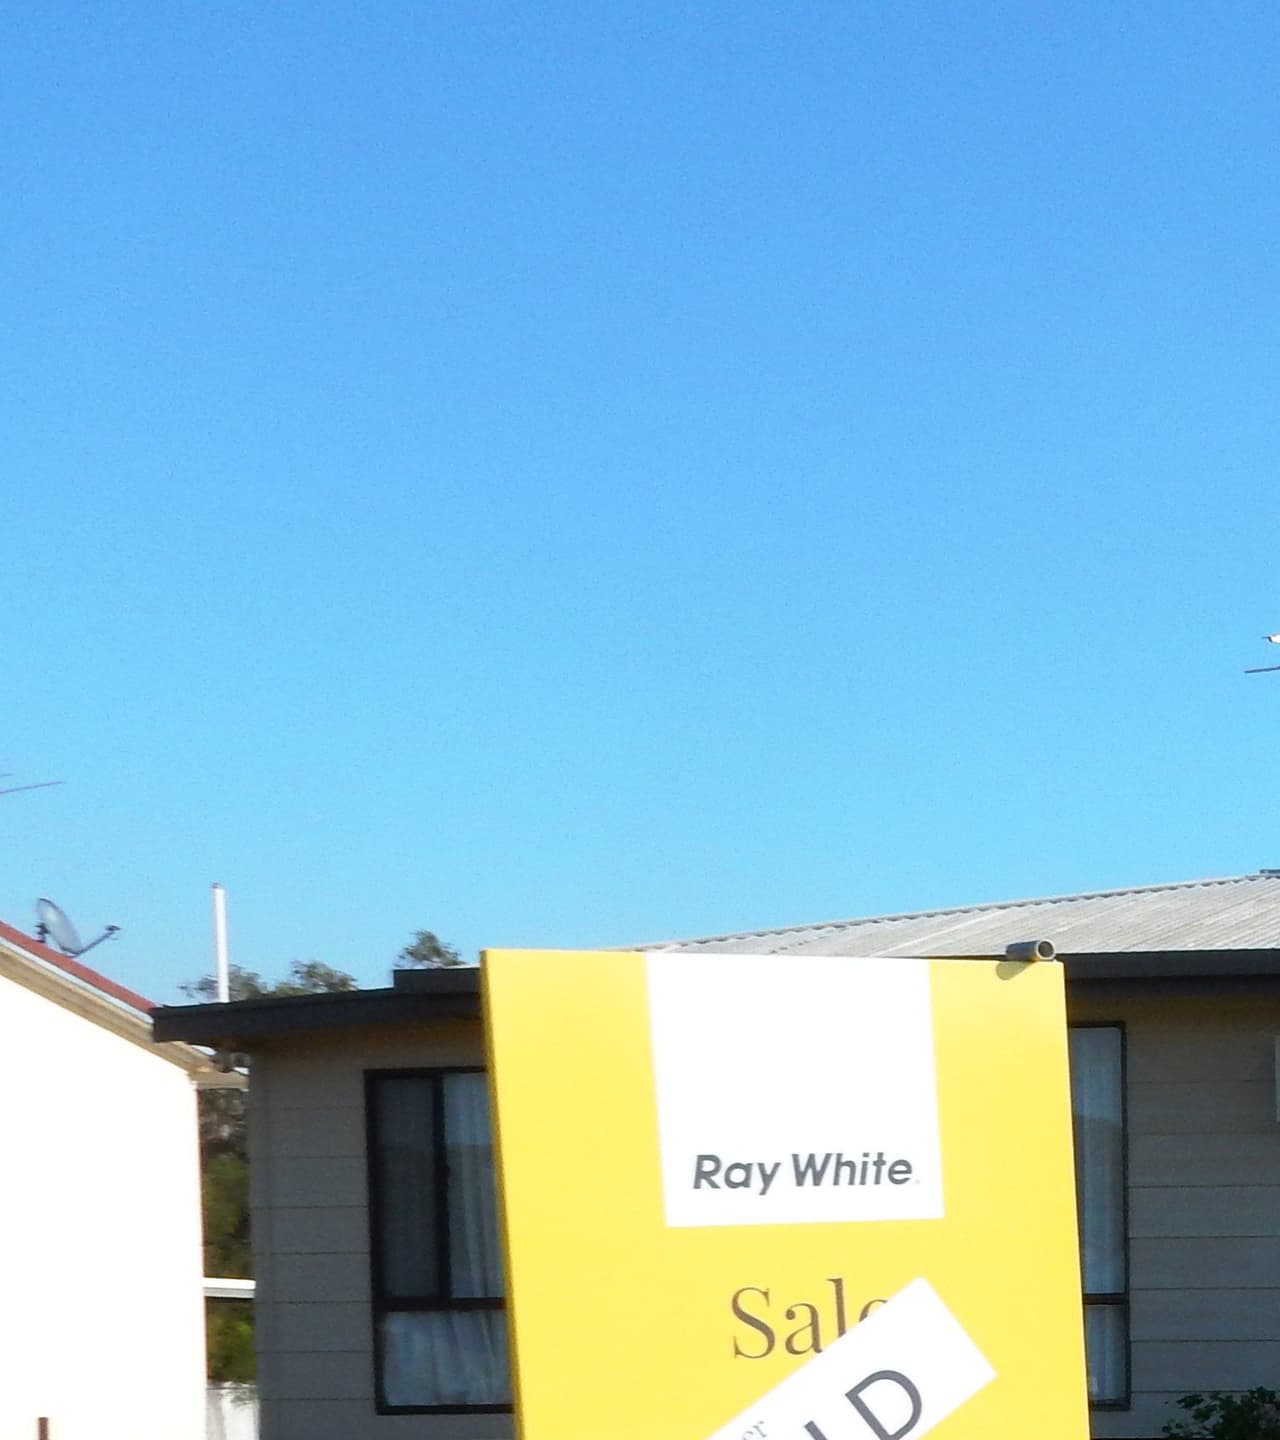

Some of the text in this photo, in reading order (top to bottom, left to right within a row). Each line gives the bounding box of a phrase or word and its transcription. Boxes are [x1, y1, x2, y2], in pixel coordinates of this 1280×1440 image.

[693, 1151, 913, 1196] Ray White
[731, 1277, 888, 1359] Sal
